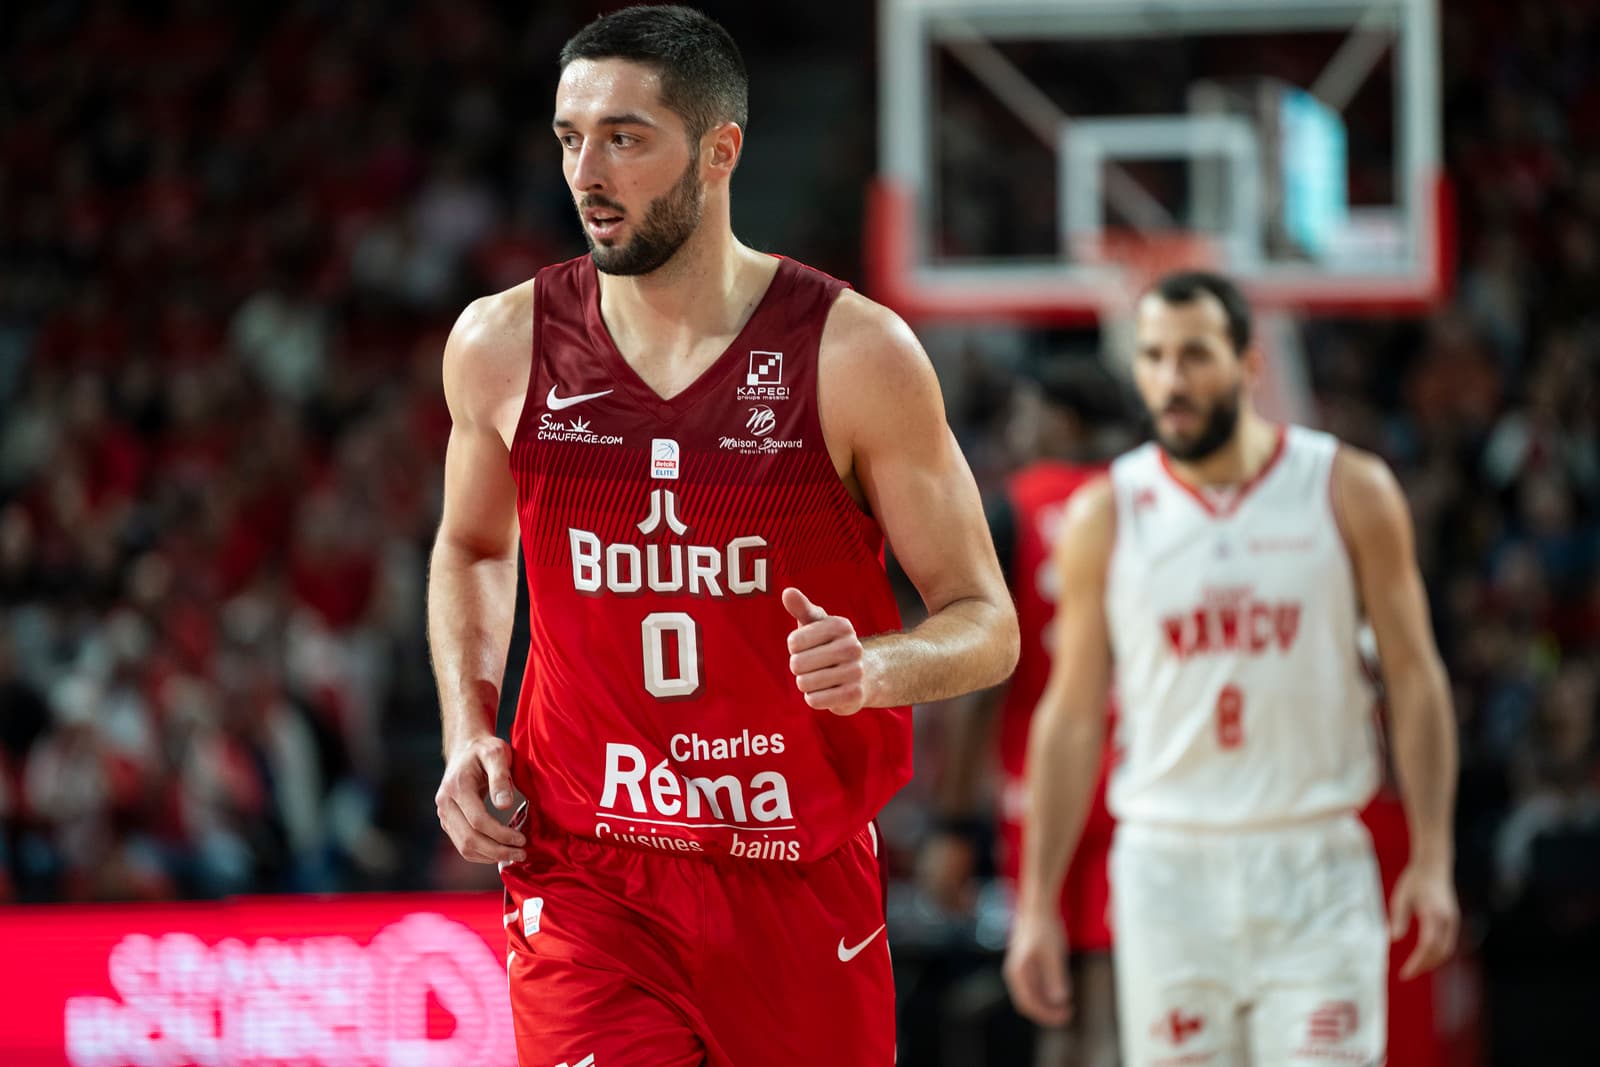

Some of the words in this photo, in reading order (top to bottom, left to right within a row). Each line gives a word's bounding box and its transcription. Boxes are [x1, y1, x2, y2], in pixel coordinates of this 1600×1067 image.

[736, 386, 790, 396] KAPECI
[538, 413, 565, 431] Sun
[537, 430, 624, 445] CHAUFFAGE.COM
[718, 436, 758, 450] Maison
[758, 436, 803, 450] Bouvard
[568, 527, 768, 597] BOURG
[641, 612, 700, 698] 0
[670, 729, 785, 762] Charles
[599, 742, 794, 823] Réma
[729, 832, 800, 861] bains
